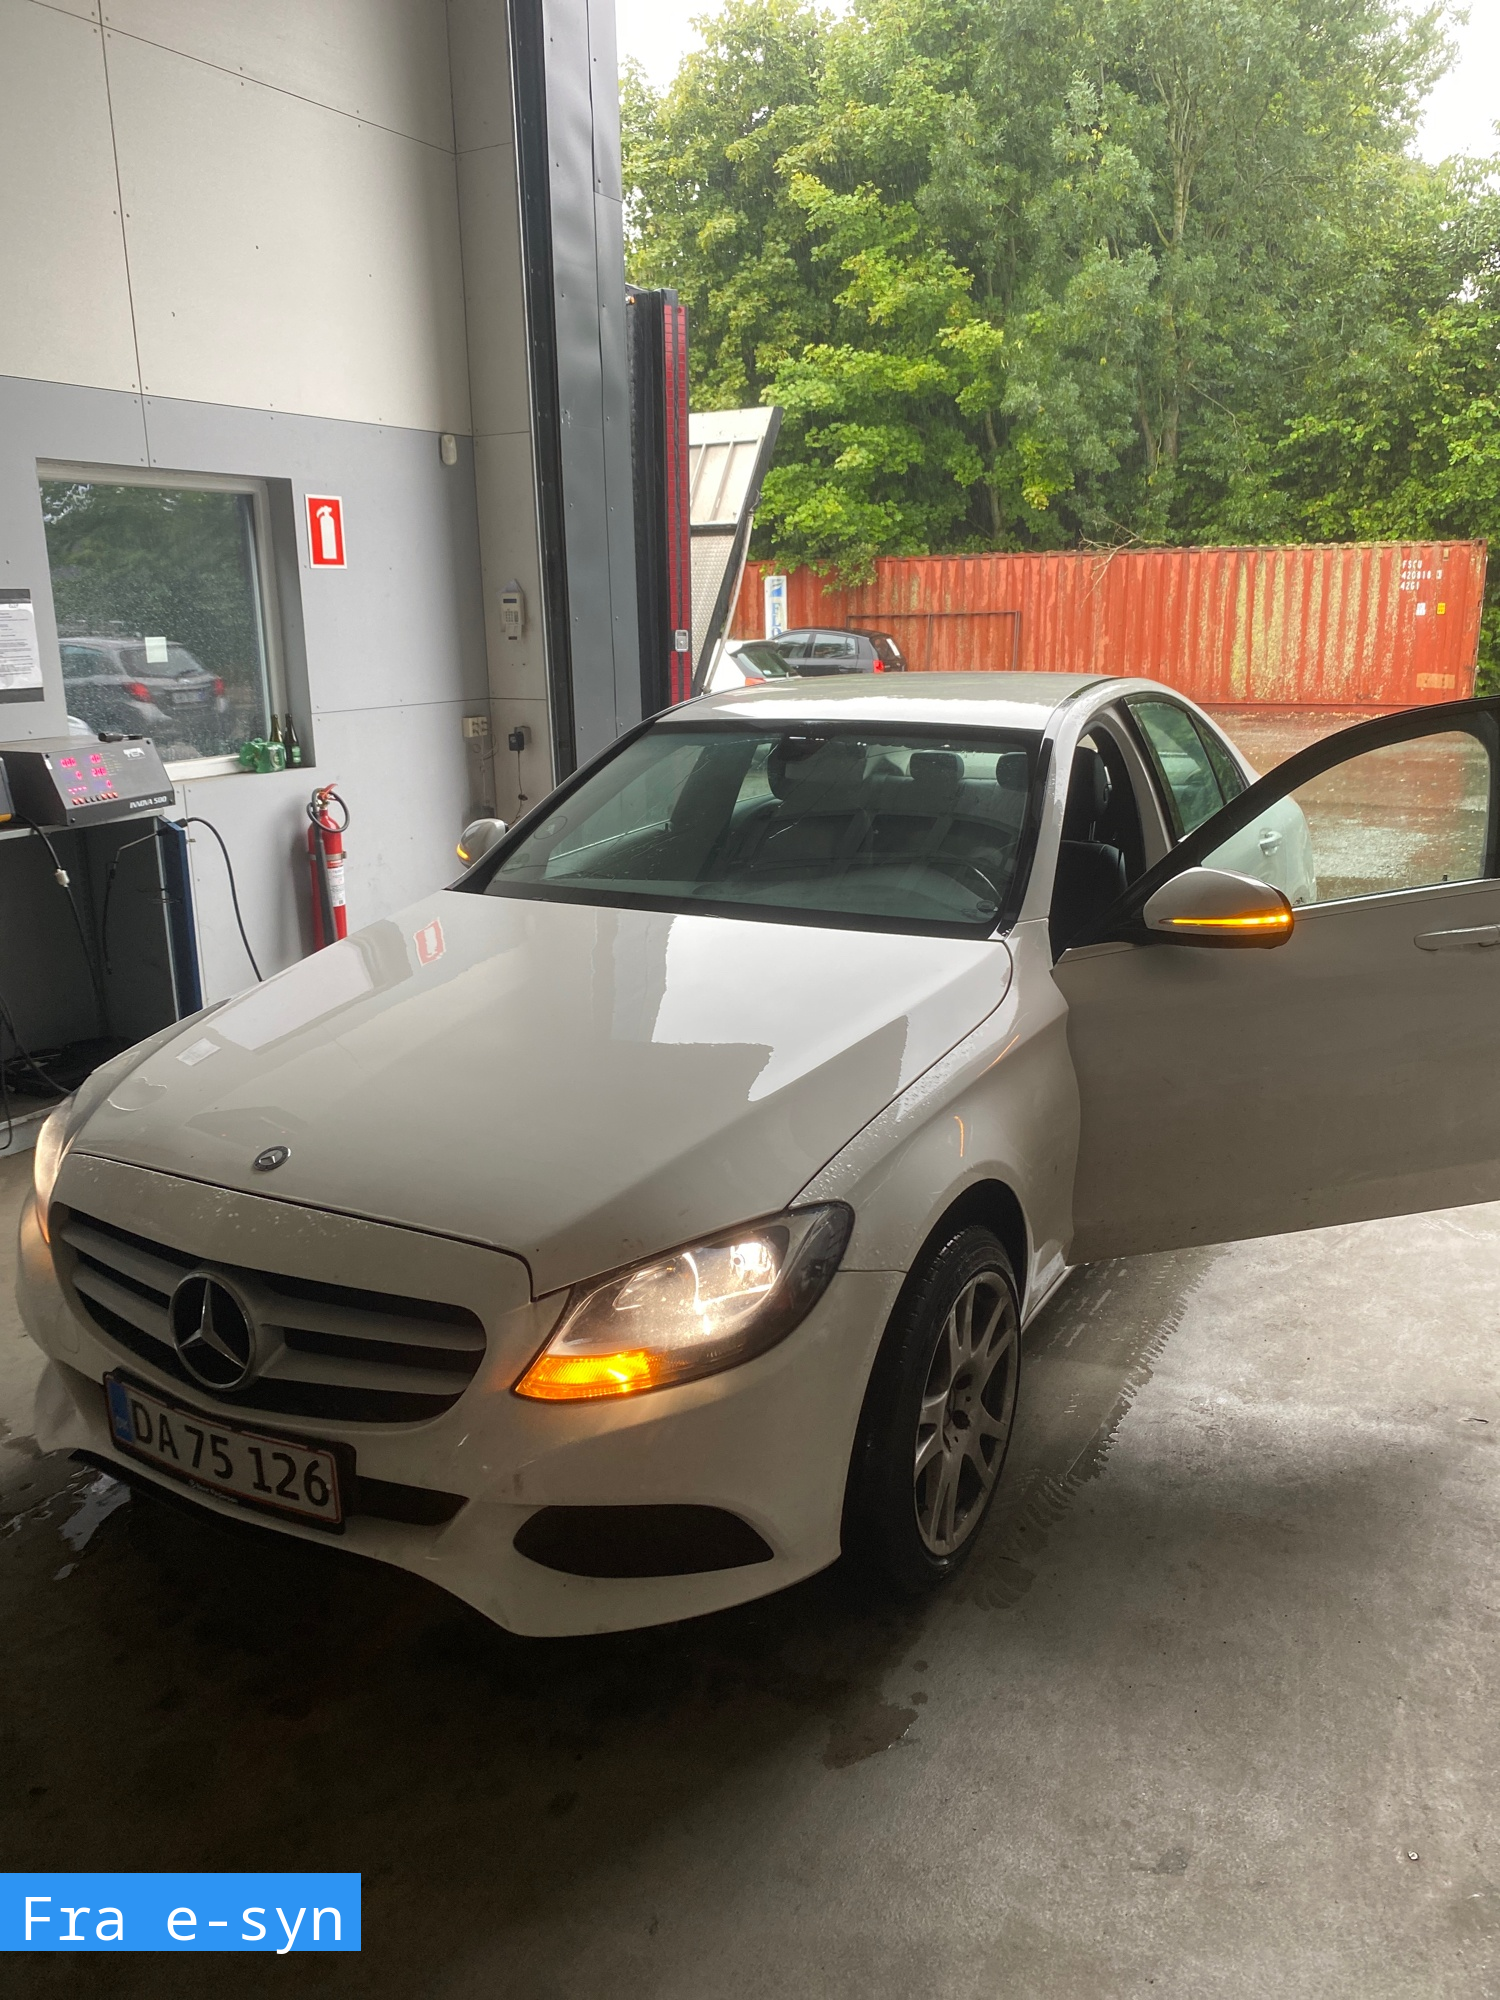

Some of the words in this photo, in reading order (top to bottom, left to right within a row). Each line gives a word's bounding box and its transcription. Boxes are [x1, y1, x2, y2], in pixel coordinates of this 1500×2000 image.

[1402, 559, 1423, 569] FSCU
[132, 1399, 179, 1460] DA
[184, 1424, 234, 1480] 75
[248, 1446, 330, 1507] 126
